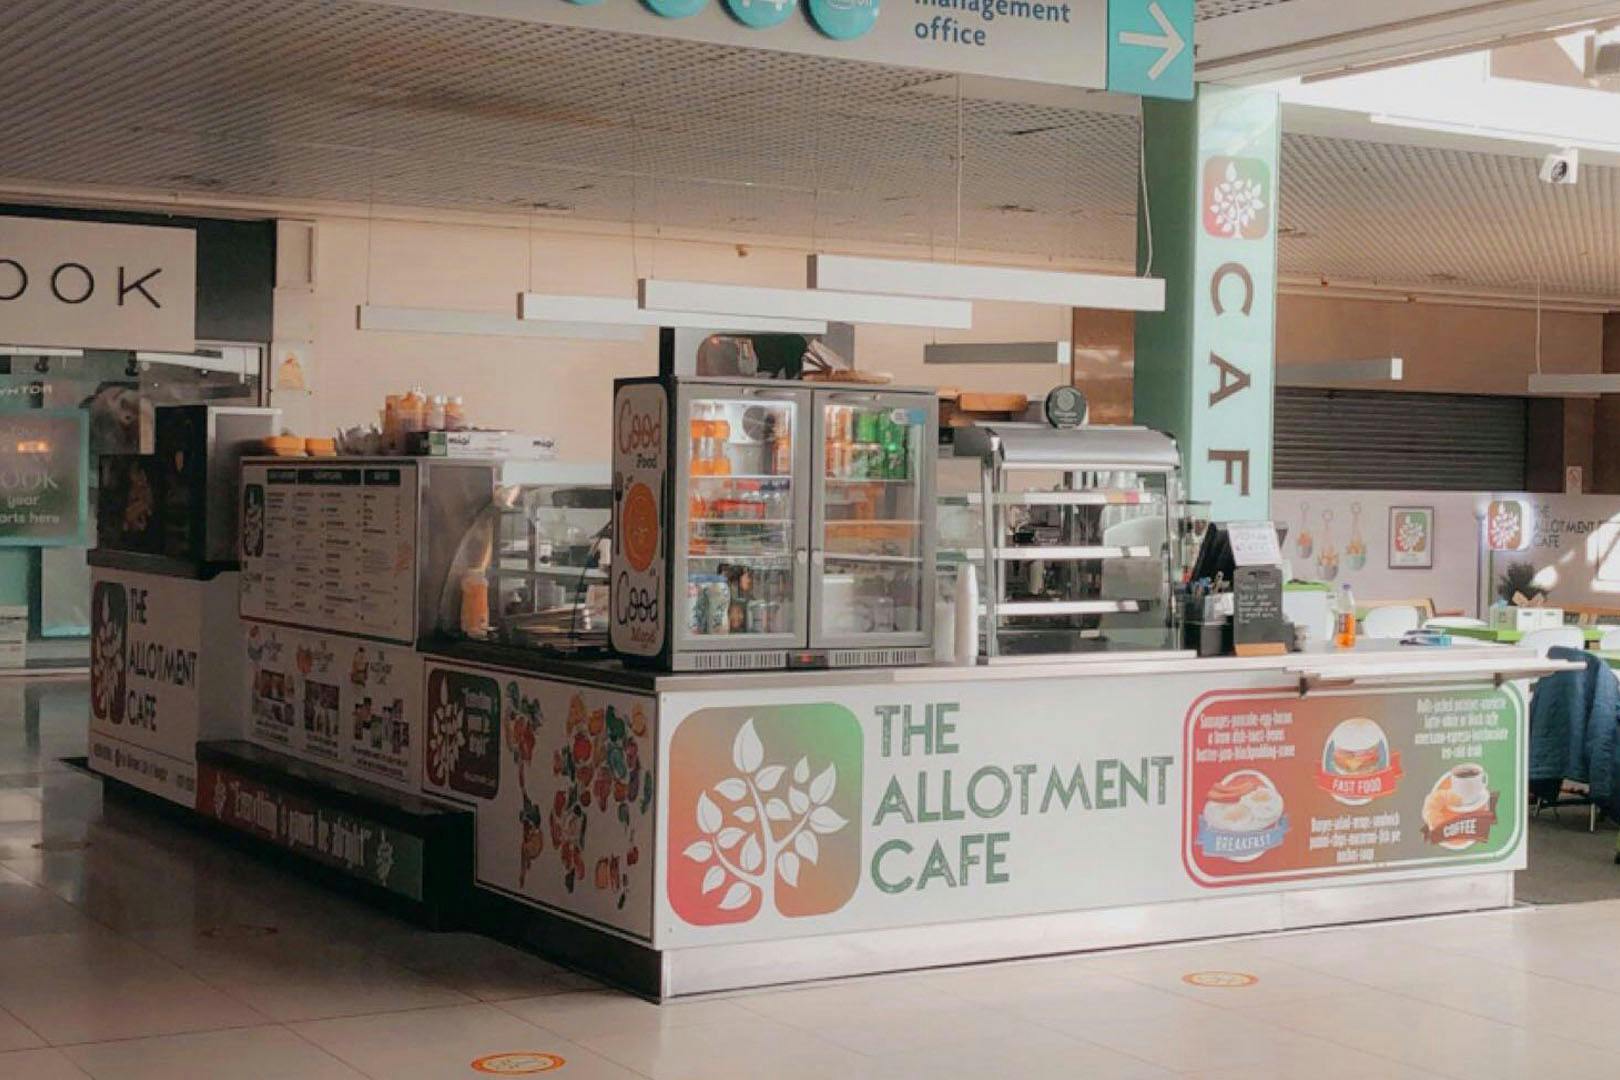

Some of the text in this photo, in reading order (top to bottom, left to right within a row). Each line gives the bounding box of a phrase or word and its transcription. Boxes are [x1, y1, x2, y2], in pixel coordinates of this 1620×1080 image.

[915, 16, 986, 46] office
[0, 259, 162, 308] OOK
[130, 587, 149, 625] THE
[129, 642, 197, 689] ALLOTMENT
[128, 691, 157, 732] CAFE
[874, 702, 961, 758] THE
[872, 755, 1175, 827] ALLOTMENT
[1332, 777, 1382, 795] FAST FOOD
[1215, 832, 1272, 852] BREAKFAST
[1443, 817, 1478, 838] COFFEE
[870, 832, 1011, 895] CAFE
